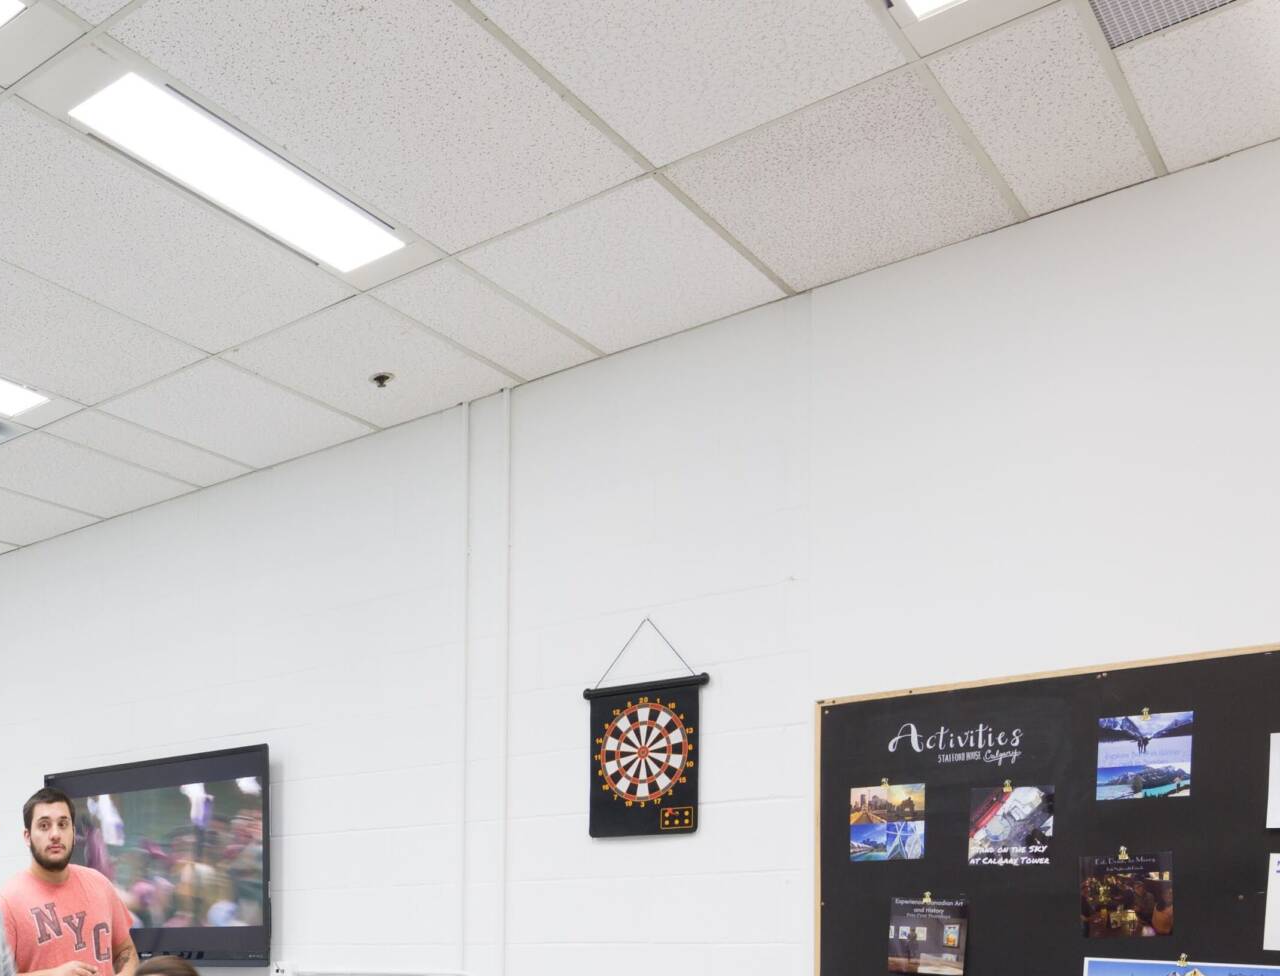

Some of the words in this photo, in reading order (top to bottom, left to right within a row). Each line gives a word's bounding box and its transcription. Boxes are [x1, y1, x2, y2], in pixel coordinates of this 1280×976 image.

[888, 722, 1023, 752] Activities
[1029, 845, 1048, 853] SKY
[1021, 856, 1050, 865] TOWER
[30, 902, 111, 962] NYC
